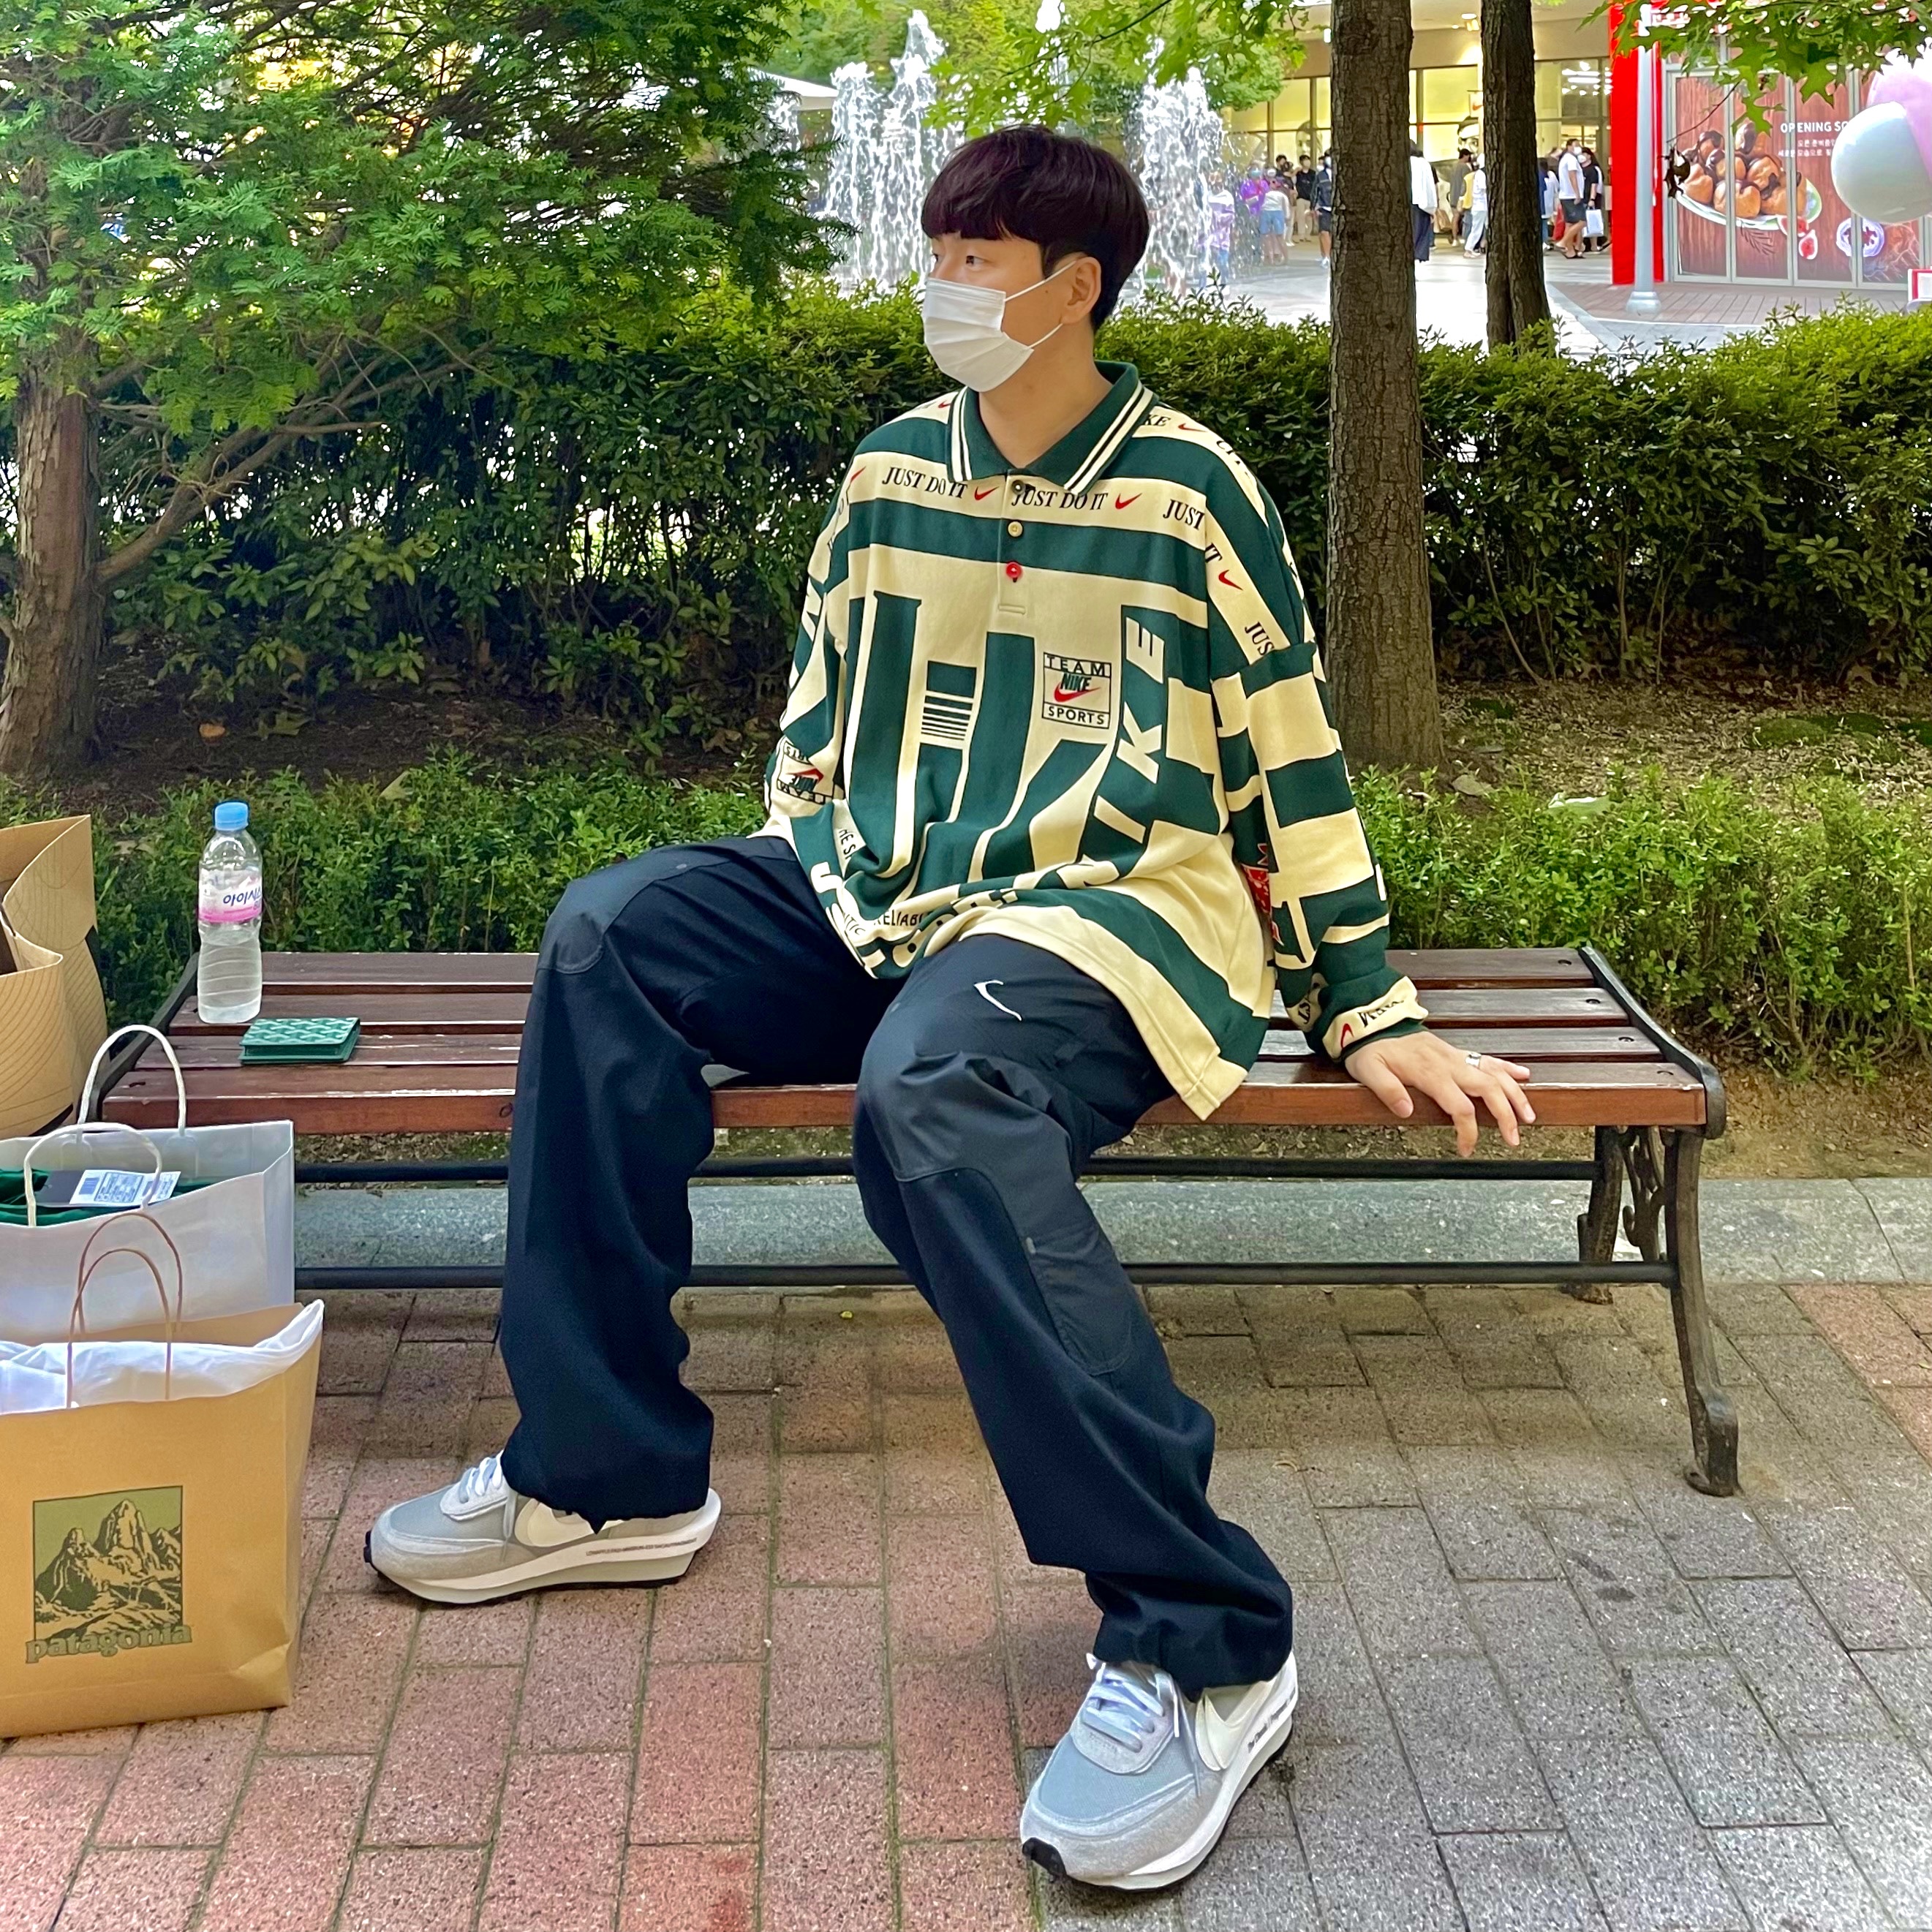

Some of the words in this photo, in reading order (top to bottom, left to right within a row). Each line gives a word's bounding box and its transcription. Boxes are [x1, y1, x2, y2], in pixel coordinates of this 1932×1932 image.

[1780, 121, 1832, 133] OPENING
[1834, 121, 1849, 132] SO
[882, 467, 926, 489] JUST
[925, 476, 947, 496] DO
[948, 482, 968, 499] IT
[1011, 488, 1058, 507] JUST
[1059, 491, 1088, 510] DO
[1090, 492, 1109, 511] IT
[1163, 499, 1206, 531] JUST
[1245, 621, 1275, 656] JUS
[1046, 655, 1106, 677] TEAM
[1060, 671, 1093, 692] NIKE
[1048, 706, 1105, 725] SPORTS
[25, 1623, 193, 1664] patagonia
